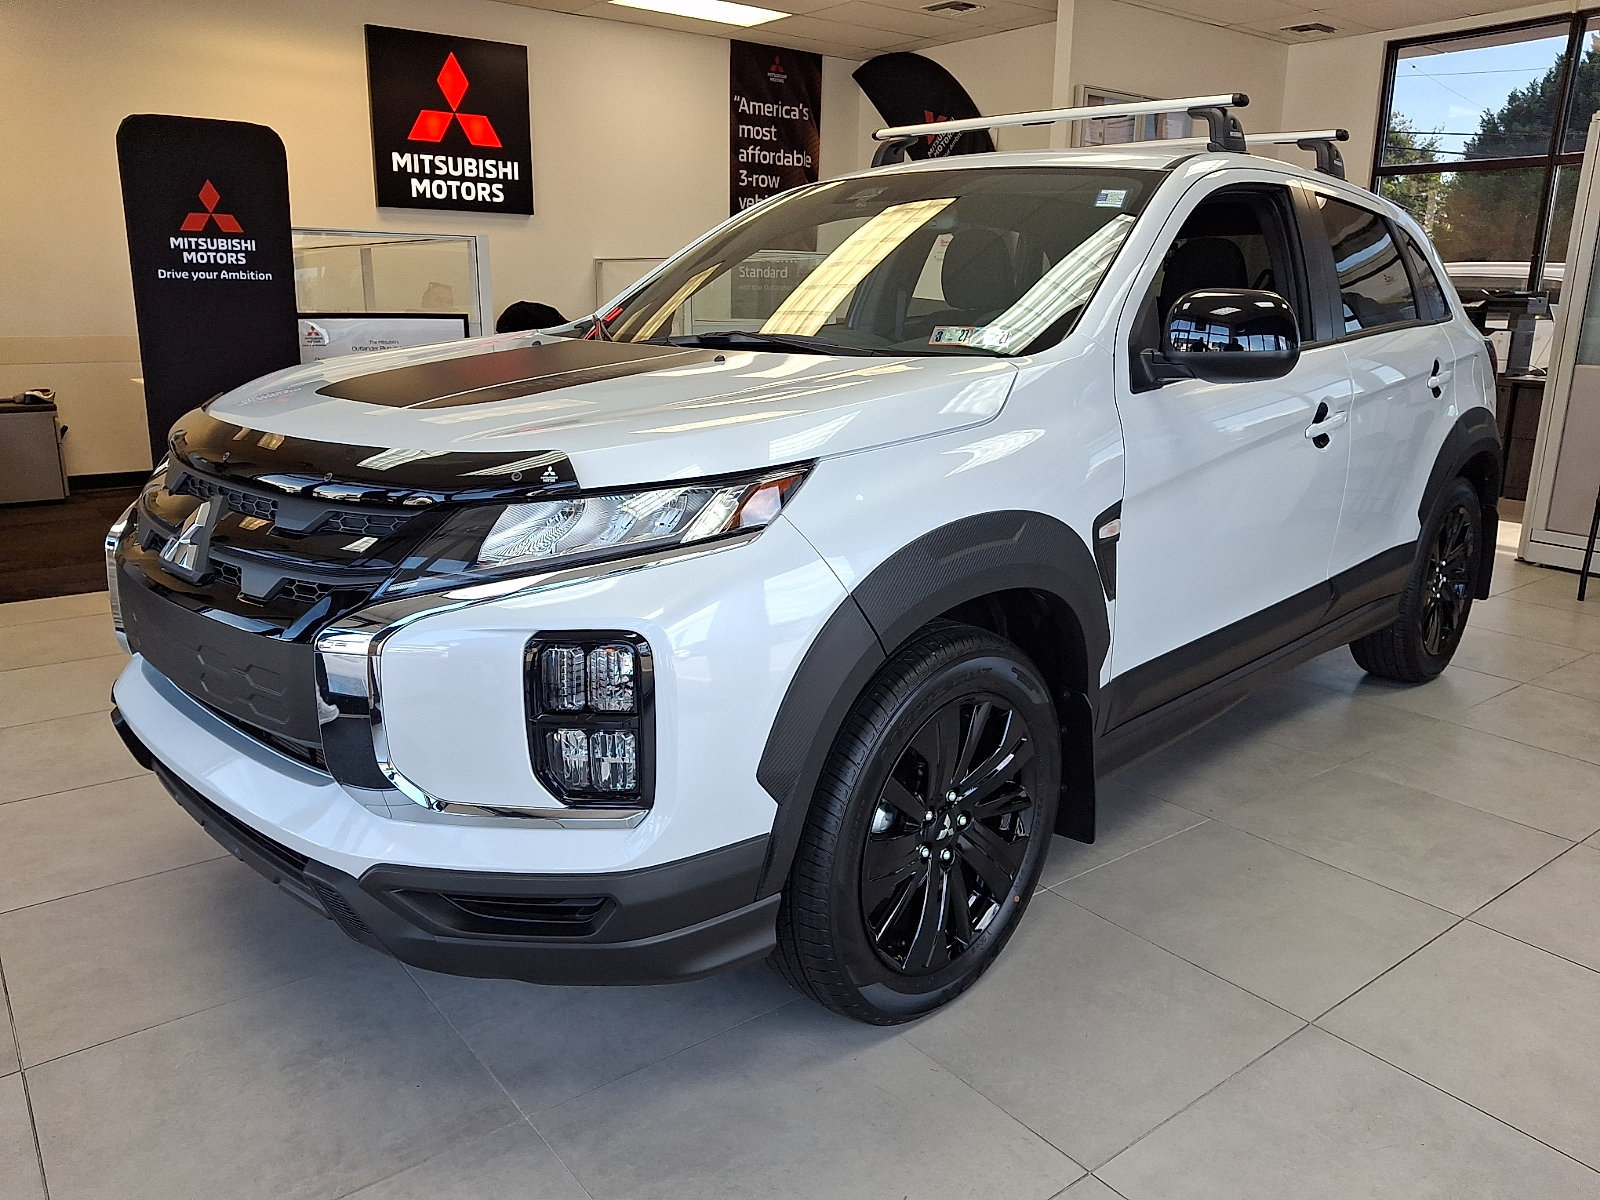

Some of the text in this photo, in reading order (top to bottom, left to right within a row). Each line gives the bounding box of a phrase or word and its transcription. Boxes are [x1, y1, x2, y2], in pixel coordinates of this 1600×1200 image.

[738, 124, 778, 141] most
[738, 145, 812, 168] affordable
[391, 151, 519, 181] MITSUBISHI
[738, 169, 780, 189] 3-row
[410, 177, 505, 203] MOTORS
[169, 236, 256, 252] MITSUBISHI
[182, 251, 247, 265] MOTORS
[157, 269, 273, 281] Drive your Ambition
[739, 266, 788, 279] Standard
[935, 329, 970, 342] 3 27
